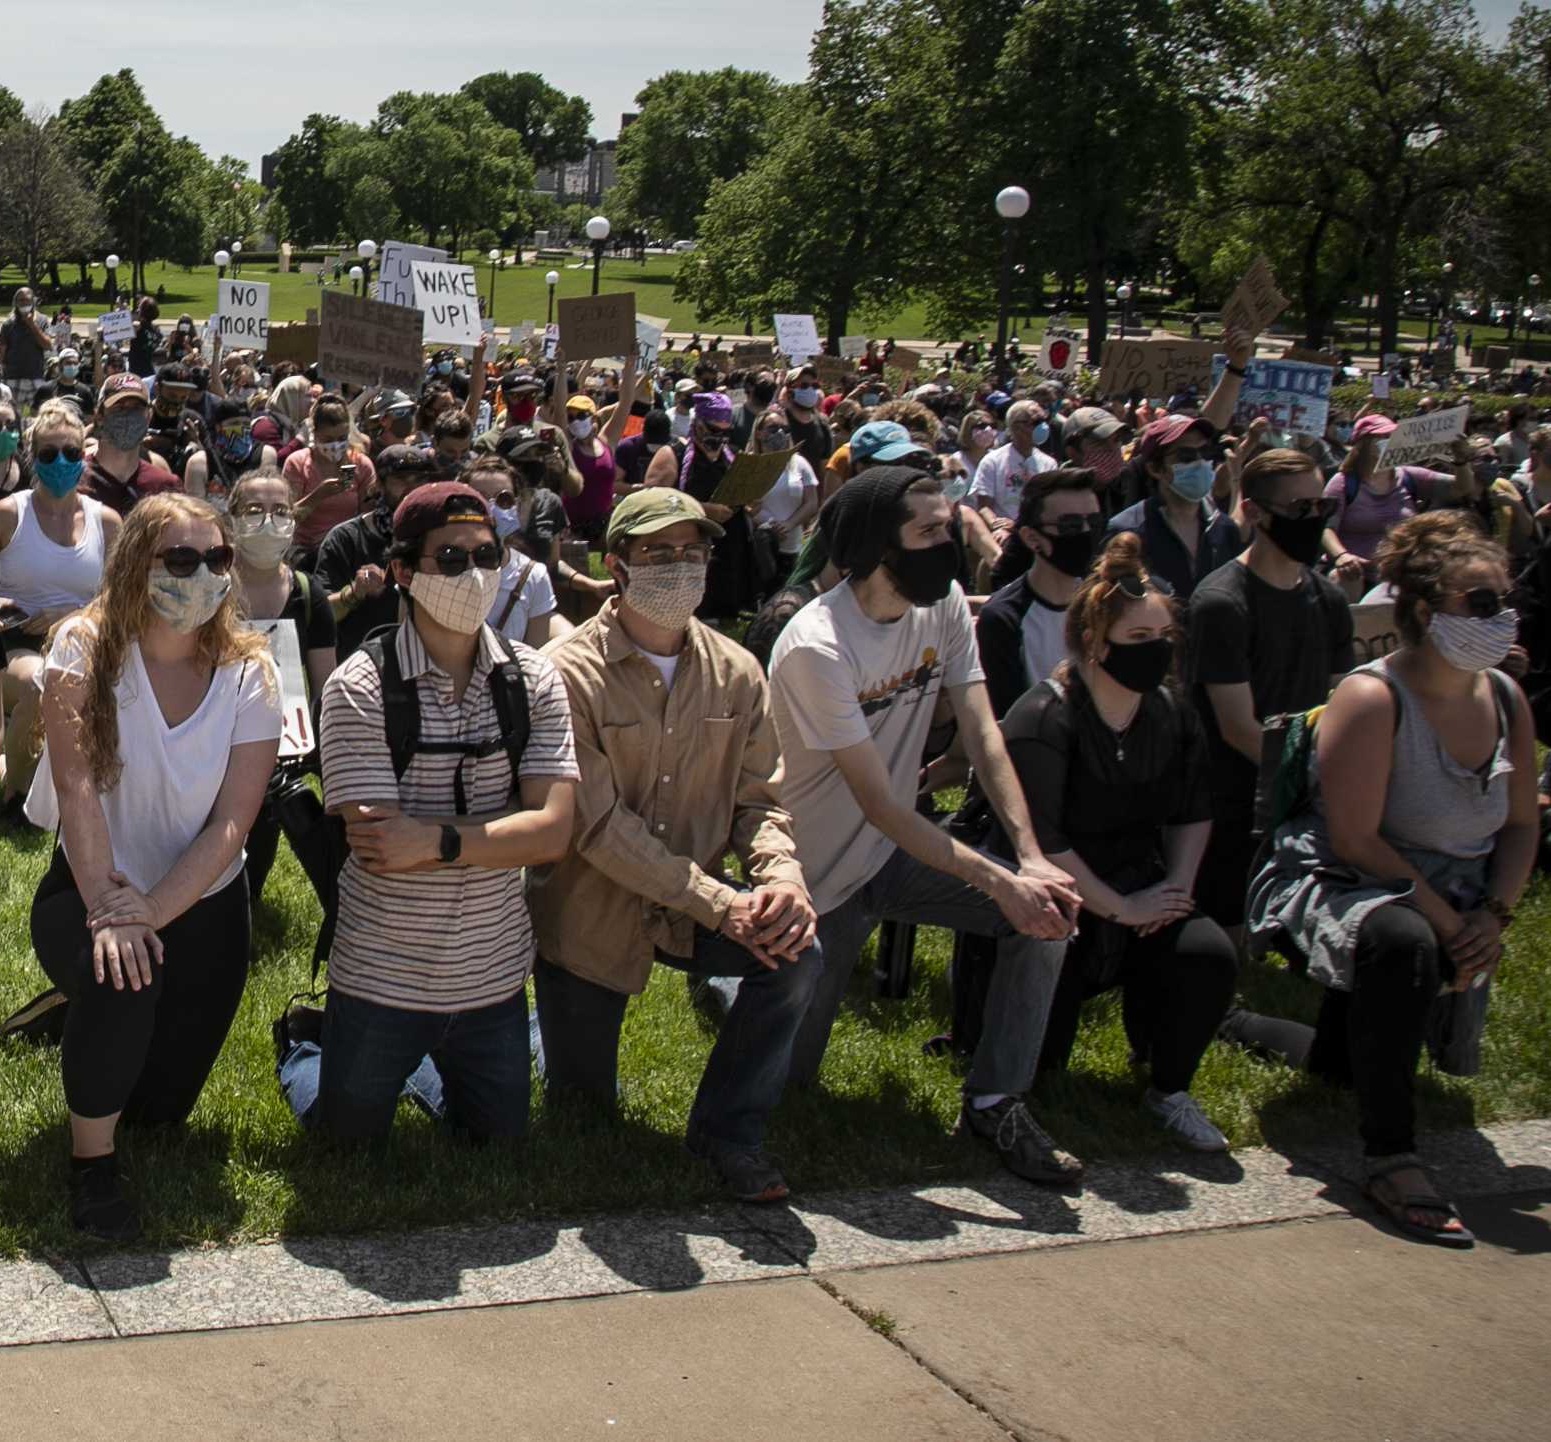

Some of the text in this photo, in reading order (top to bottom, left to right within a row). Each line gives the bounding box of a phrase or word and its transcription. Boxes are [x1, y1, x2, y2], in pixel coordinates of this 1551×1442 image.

[231, 286, 258, 306] NO
[417, 269, 477, 298] WAKE
[219, 315, 268, 337] MORE
[432, 304, 472, 336] UP!
